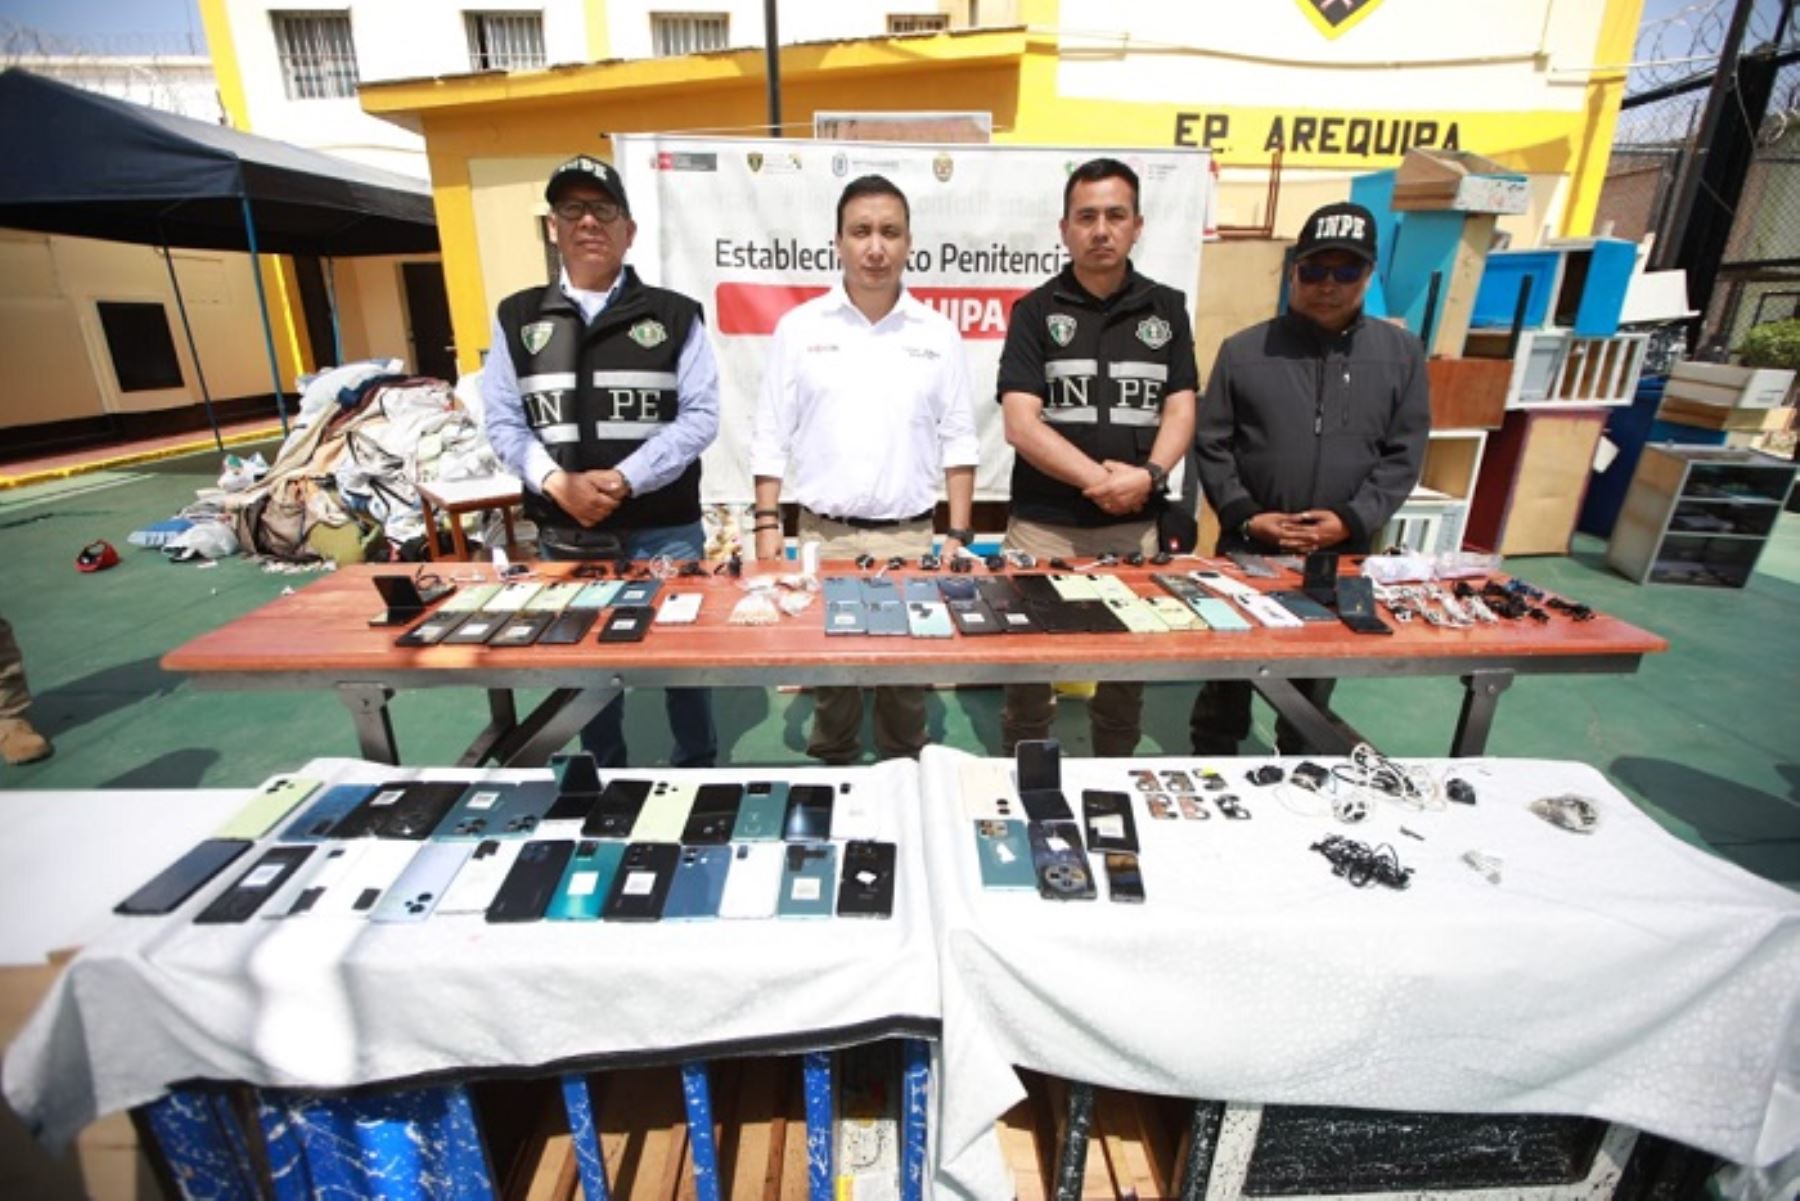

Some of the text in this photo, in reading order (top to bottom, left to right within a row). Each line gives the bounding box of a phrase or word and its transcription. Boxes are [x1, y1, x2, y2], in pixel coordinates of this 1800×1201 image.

[1264, 115, 1459, 156] AREQUIPA
[1316, 214, 1366, 242] INPE
[608, 389, 661, 421] PE
[1117, 379, 1162, 409] PE
